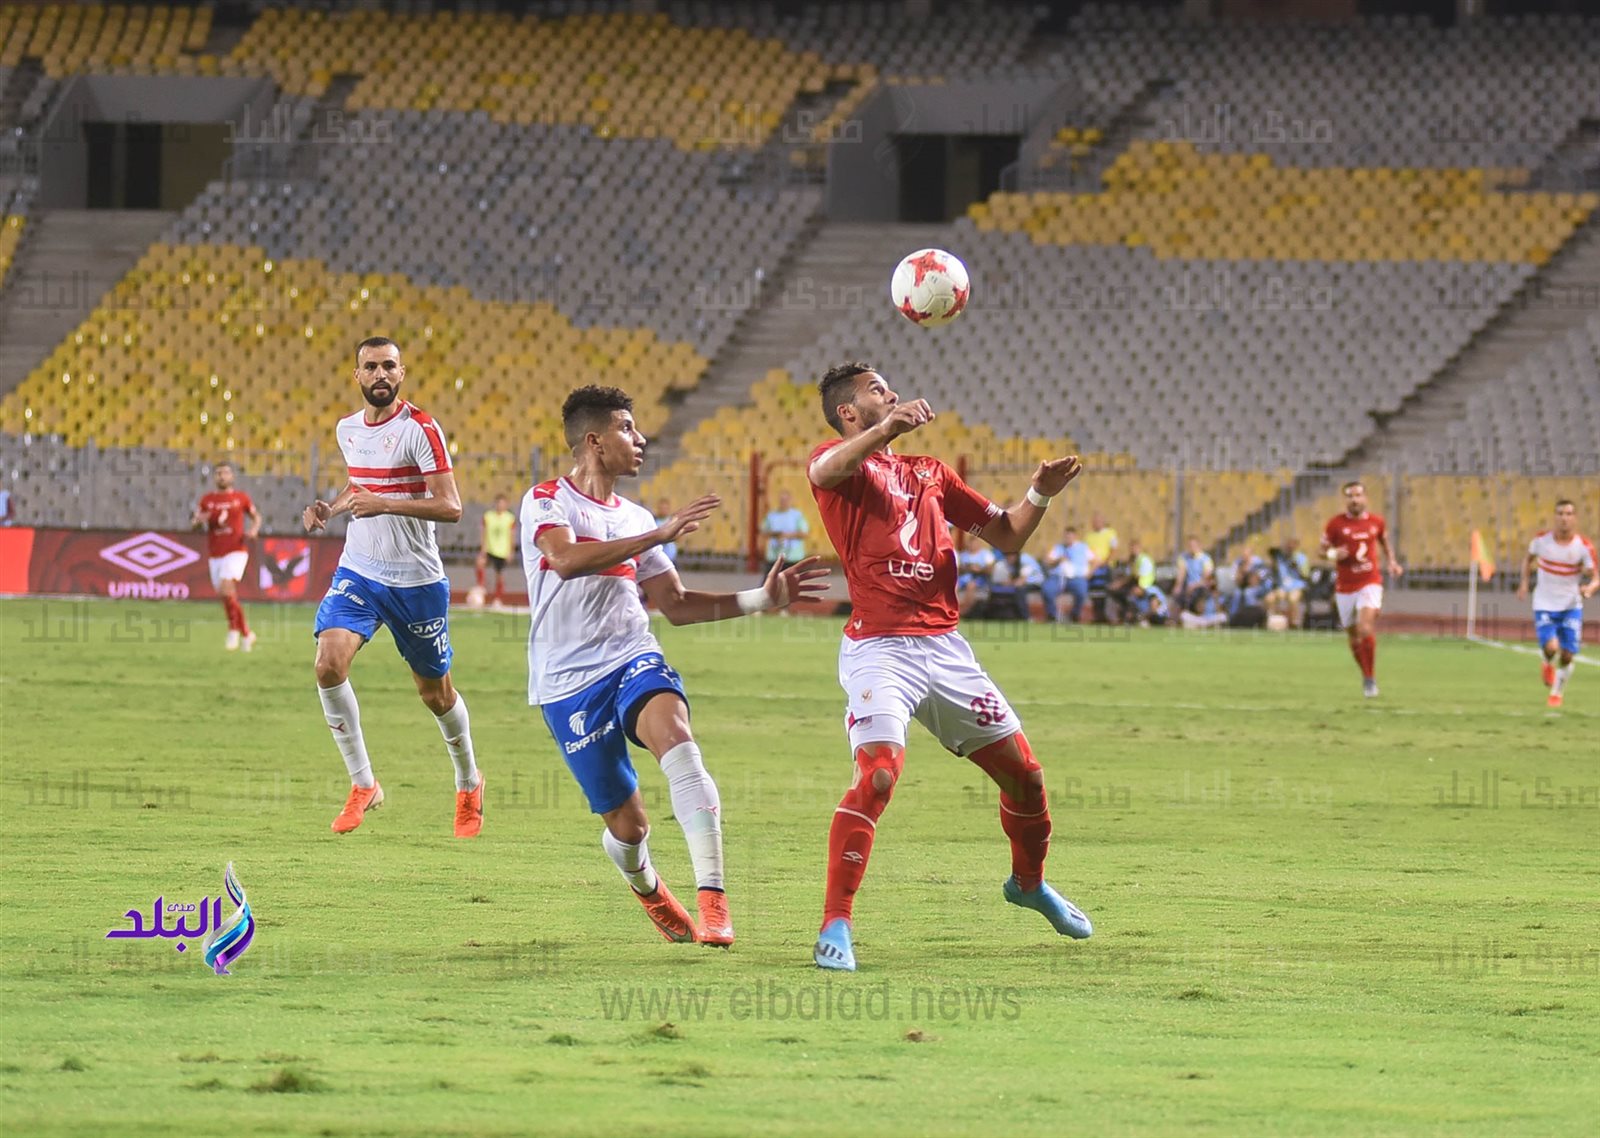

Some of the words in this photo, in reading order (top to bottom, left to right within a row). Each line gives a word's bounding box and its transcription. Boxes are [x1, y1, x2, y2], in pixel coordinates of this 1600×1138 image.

[888, 560, 934, 581] we
[108, 578, 189, 599] umbro
[413, 620, 441, 634] JAC
[970, 691, 1008, 727] 32
